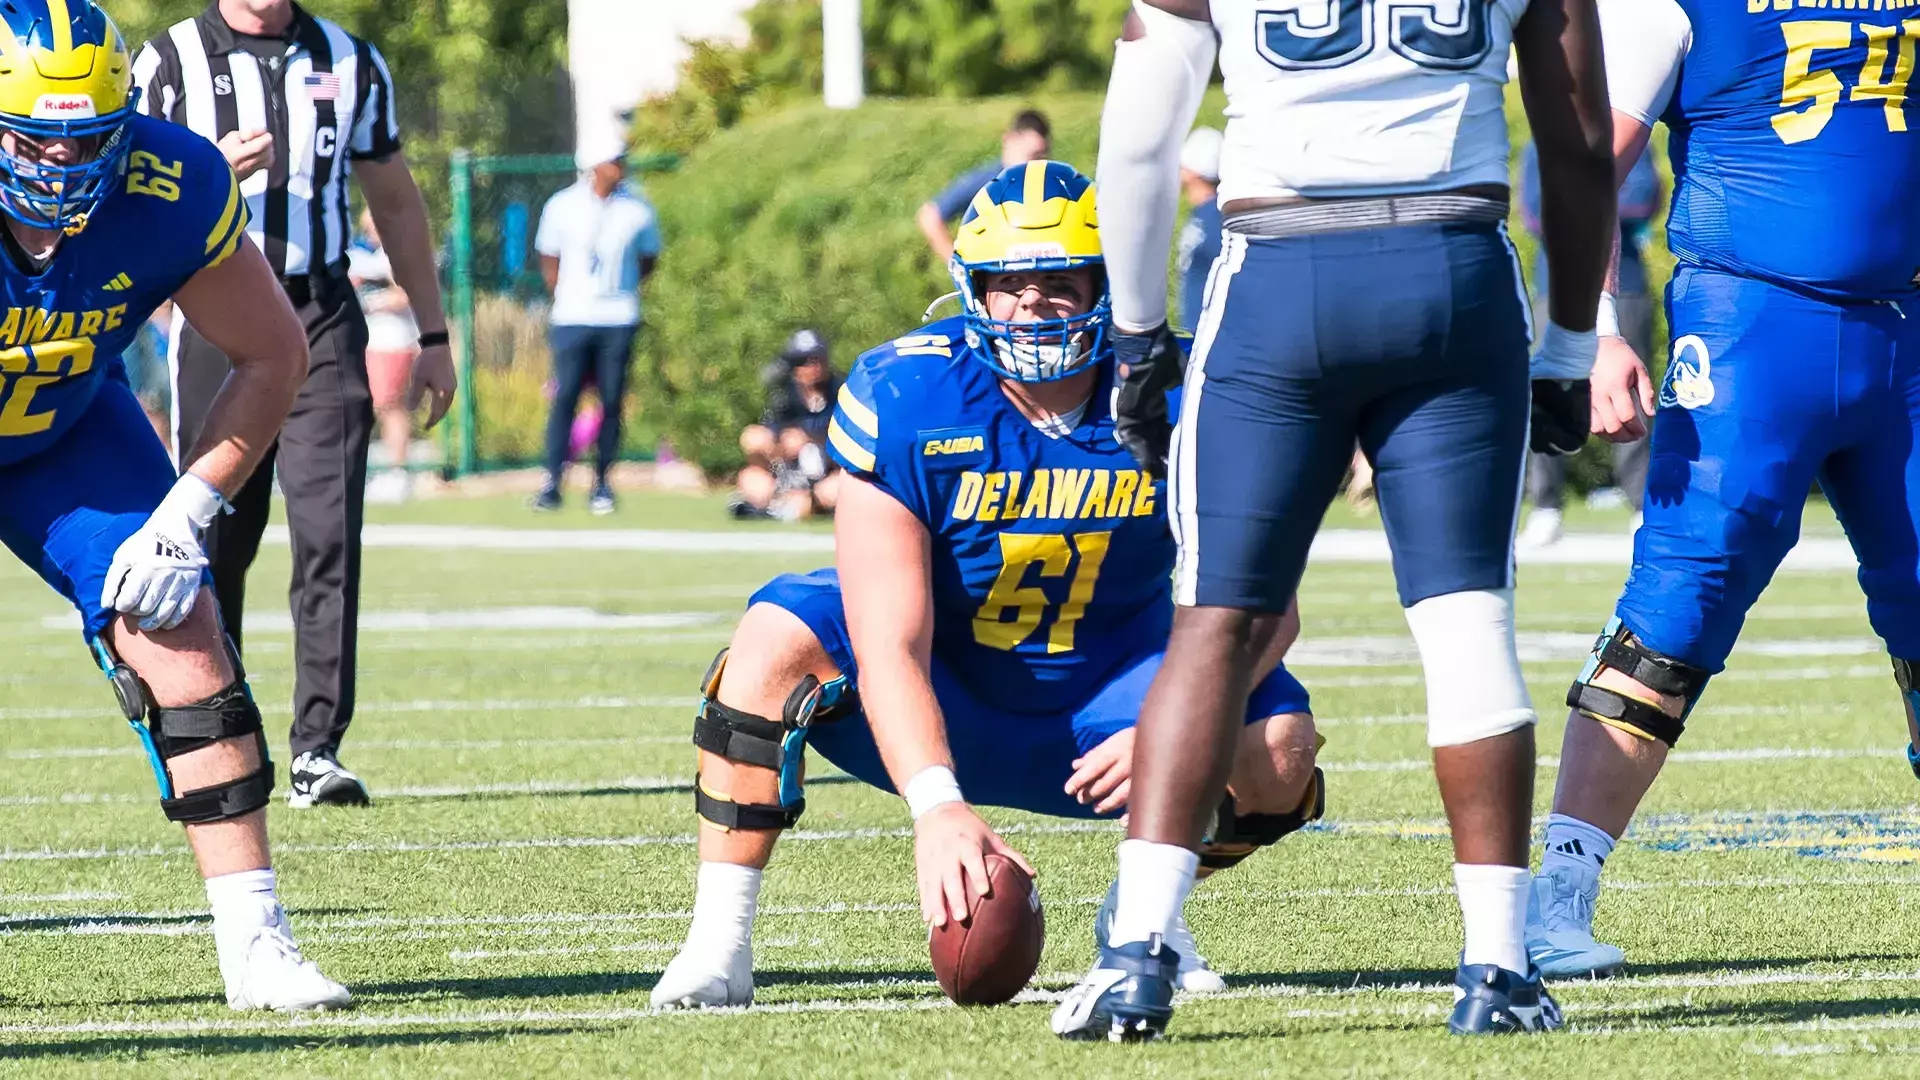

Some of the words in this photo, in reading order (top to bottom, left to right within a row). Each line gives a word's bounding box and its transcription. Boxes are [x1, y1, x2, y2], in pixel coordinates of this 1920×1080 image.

[214, 74, 233, 95] S
[1770, 20, 1920, 145] 54
[315, 126, 336, 157] C
[126, 150, 183, 202] 62
[893, 334, 952, 358] 61
[952, 468, 1156, 522] DELAWARE
[972, 531, 1113, 654] 61
